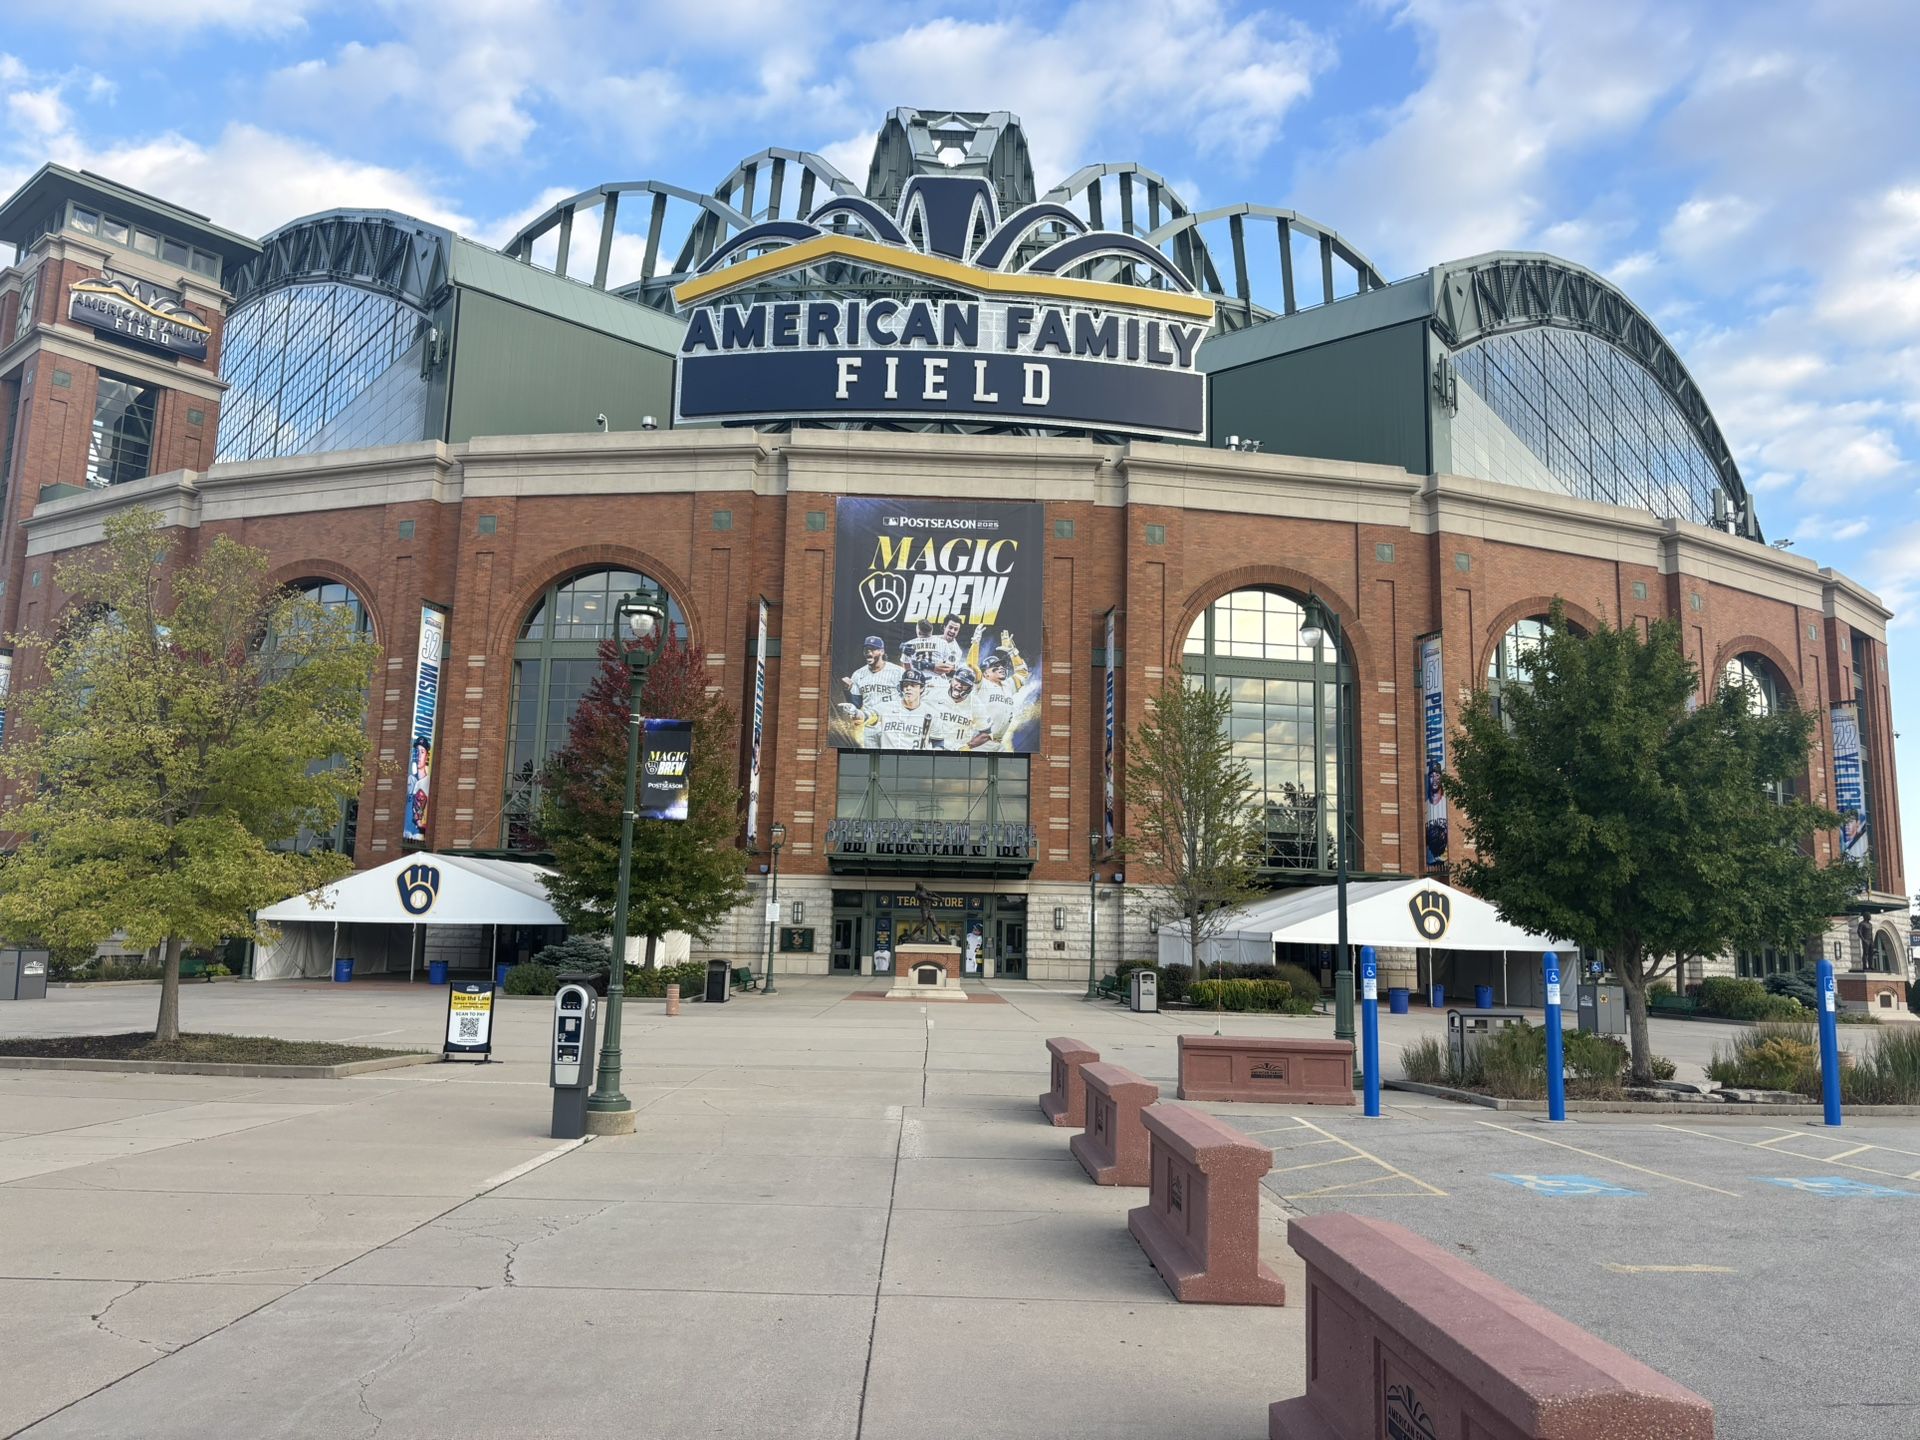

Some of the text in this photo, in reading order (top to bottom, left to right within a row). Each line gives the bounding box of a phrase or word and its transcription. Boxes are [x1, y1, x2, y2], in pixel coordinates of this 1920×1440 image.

[73, 292, 208, 344] AMERICAN FAMILY
[115, 318, 169, 344] FIELD
[682, 298, 1202, 368] AMERICAN FAMILY
[835, 356, 1052, 406] FIELD
[900, 516, 999, 530] POSTSEASON 2025
[868, 535, 1019, 575] MAGIC
[904, 573, 1010, 626] BREW
[421, 628, 441, 662] 32
[860, 684, 893, 695] REWERS
[1425, 657, 1440, 691] 51
[1425, 691, 1444, 767] PERALTA
[1833, 724, 1857, 750] 22
[647, 750, 689, 762] MAGIC
[657, 761, 687, 776] BREW
[1833, 751, 1861, 812] YELICH
[826, 818, 1037, 848] BREWERS TEAM STORE
[896, 895, 919, 906] TEA
[1387, 1403, 1415, 1439] AMERICAN
